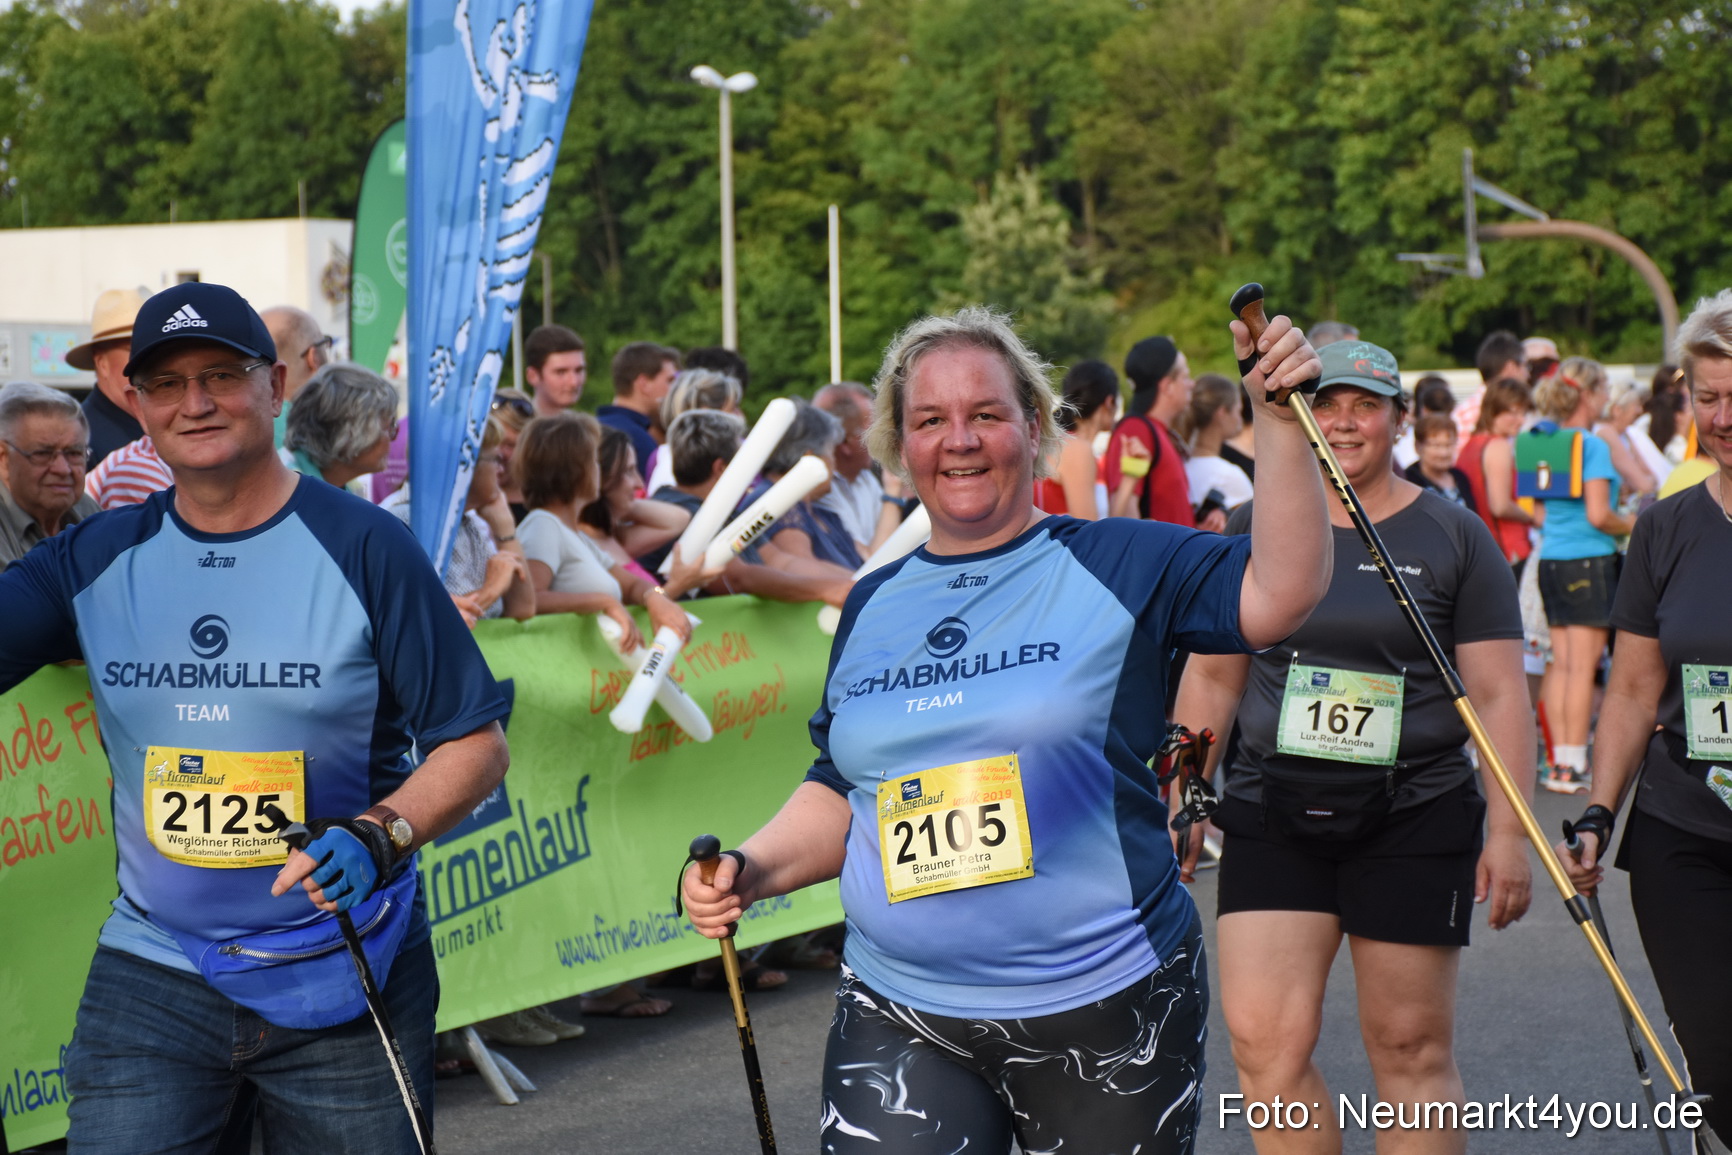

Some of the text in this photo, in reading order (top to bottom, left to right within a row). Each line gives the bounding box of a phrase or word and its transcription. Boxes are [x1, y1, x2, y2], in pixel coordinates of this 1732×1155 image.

[162, 318, 208, 333] adidas
[101, 660, 322, 690] SCHABMÜLLER
[841, 641, 1062, 705] SCHABMÜLLER
[1302, 683, 1347, 697] firmenlauf
[175, 704, 230, 721] TEAM
[905, 690, 964, 714] TEAM
[1374, 699, 1396, 708] 2019
[1307, 700, 1375, 737] 167
[1712, 700, 1729, 734] 1
[1300, 732, 1375, 749] Lux-Reif Andrea
[167, 770, 226, 785] firmenlauf
[233, 779, 293, 793] walk 2019
[894, 790, 944, 815] firmenlauf
[953, 788, 1012, 807] walk 2019
[1191, 785, 1207, 816] LEKI
[162, 791, 281, 835] 2125
[0, 783, 106, 870] aufen
[893, 803, 1007, 866] 2105
[166, 834, 281, 848] Weglöhner Richard
[184, 848, 261, 856] Schabmüller GmbH
[912, 852, 992, 875] Brauner Petra
[915, 869, 962, 884] Schabmüller
[964, 863, 990, 876] GmbH
